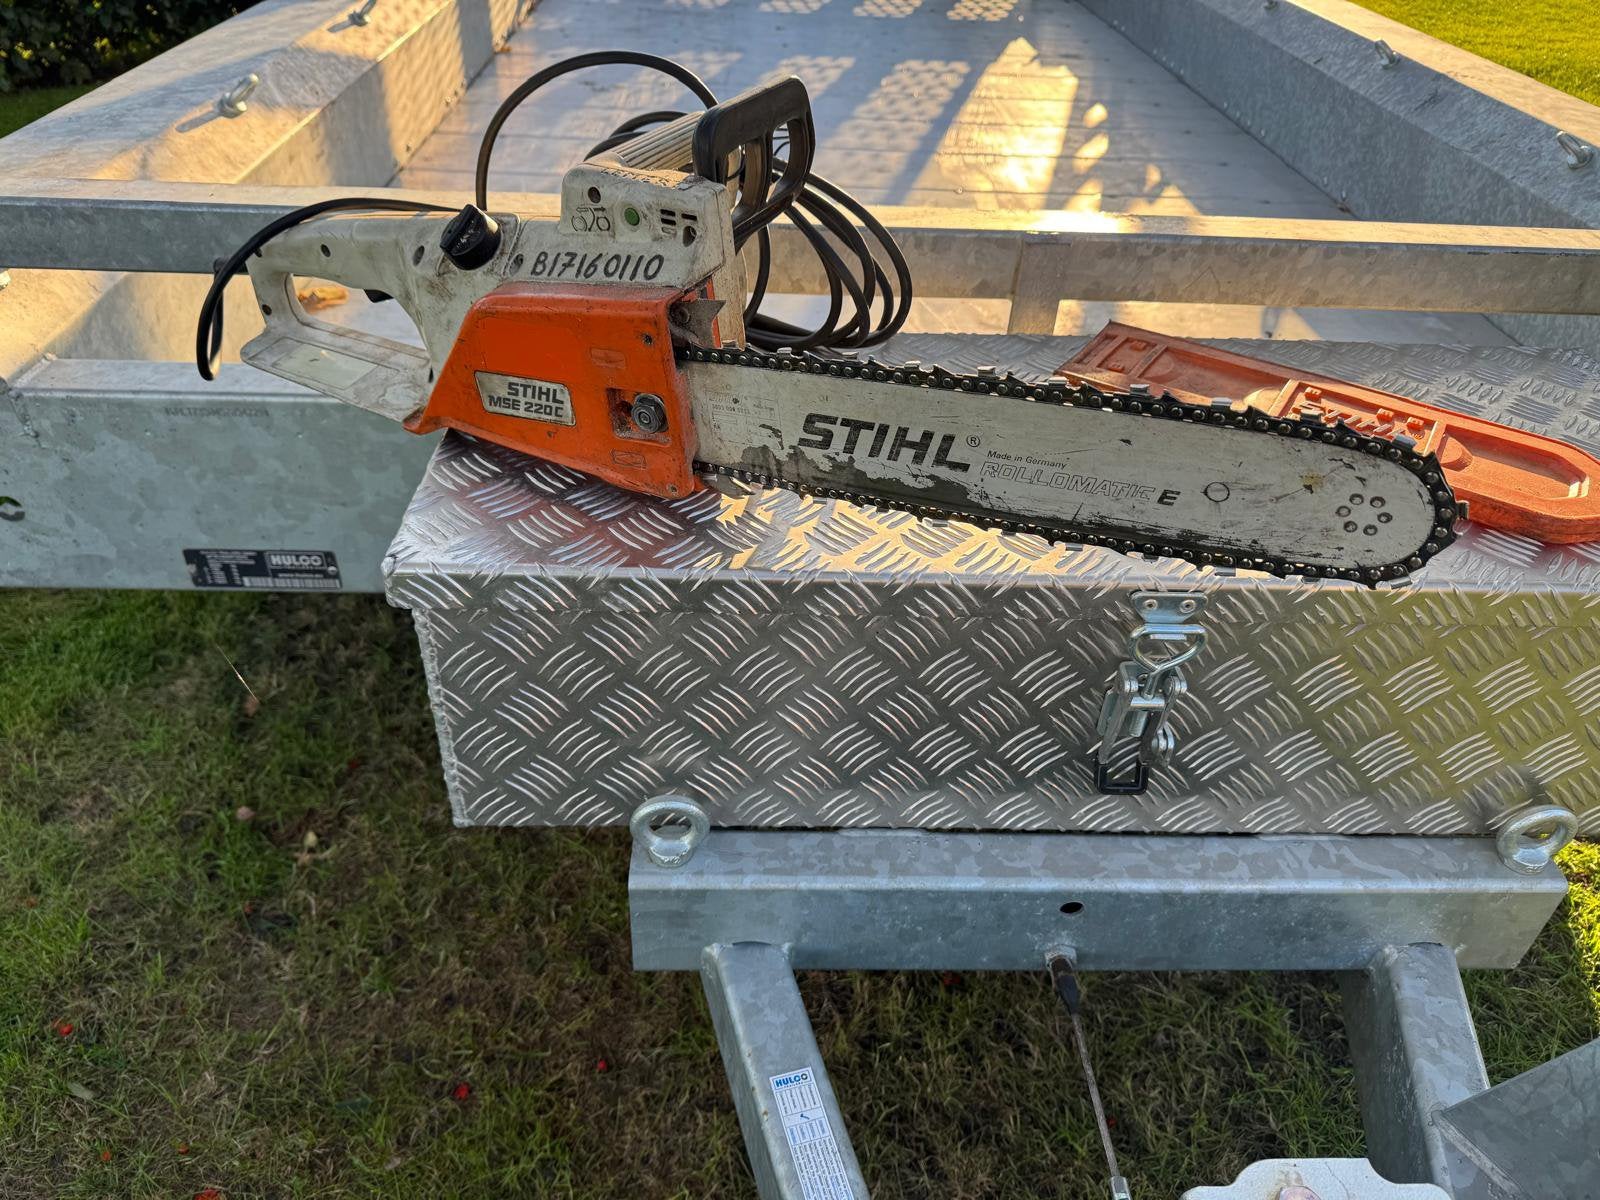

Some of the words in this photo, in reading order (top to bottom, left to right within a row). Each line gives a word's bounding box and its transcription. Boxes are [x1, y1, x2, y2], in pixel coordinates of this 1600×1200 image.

[530, 251, 665, 281] B17160110
[487, 395, 521, 411] MSE
[507, 381, 564, 404] STIHL
[797, 412, 971, 473] STIHL
[986, 450, 1012, 462] Made
[1014, 455, 1023, 463] in
[1025, 456, 1068, 469] Germany
[979, 461, 1156, 501] ROLLOMATIC
[1156, 489, 1181, 507] E
[775, 1073, 808, 1087] HULCO
